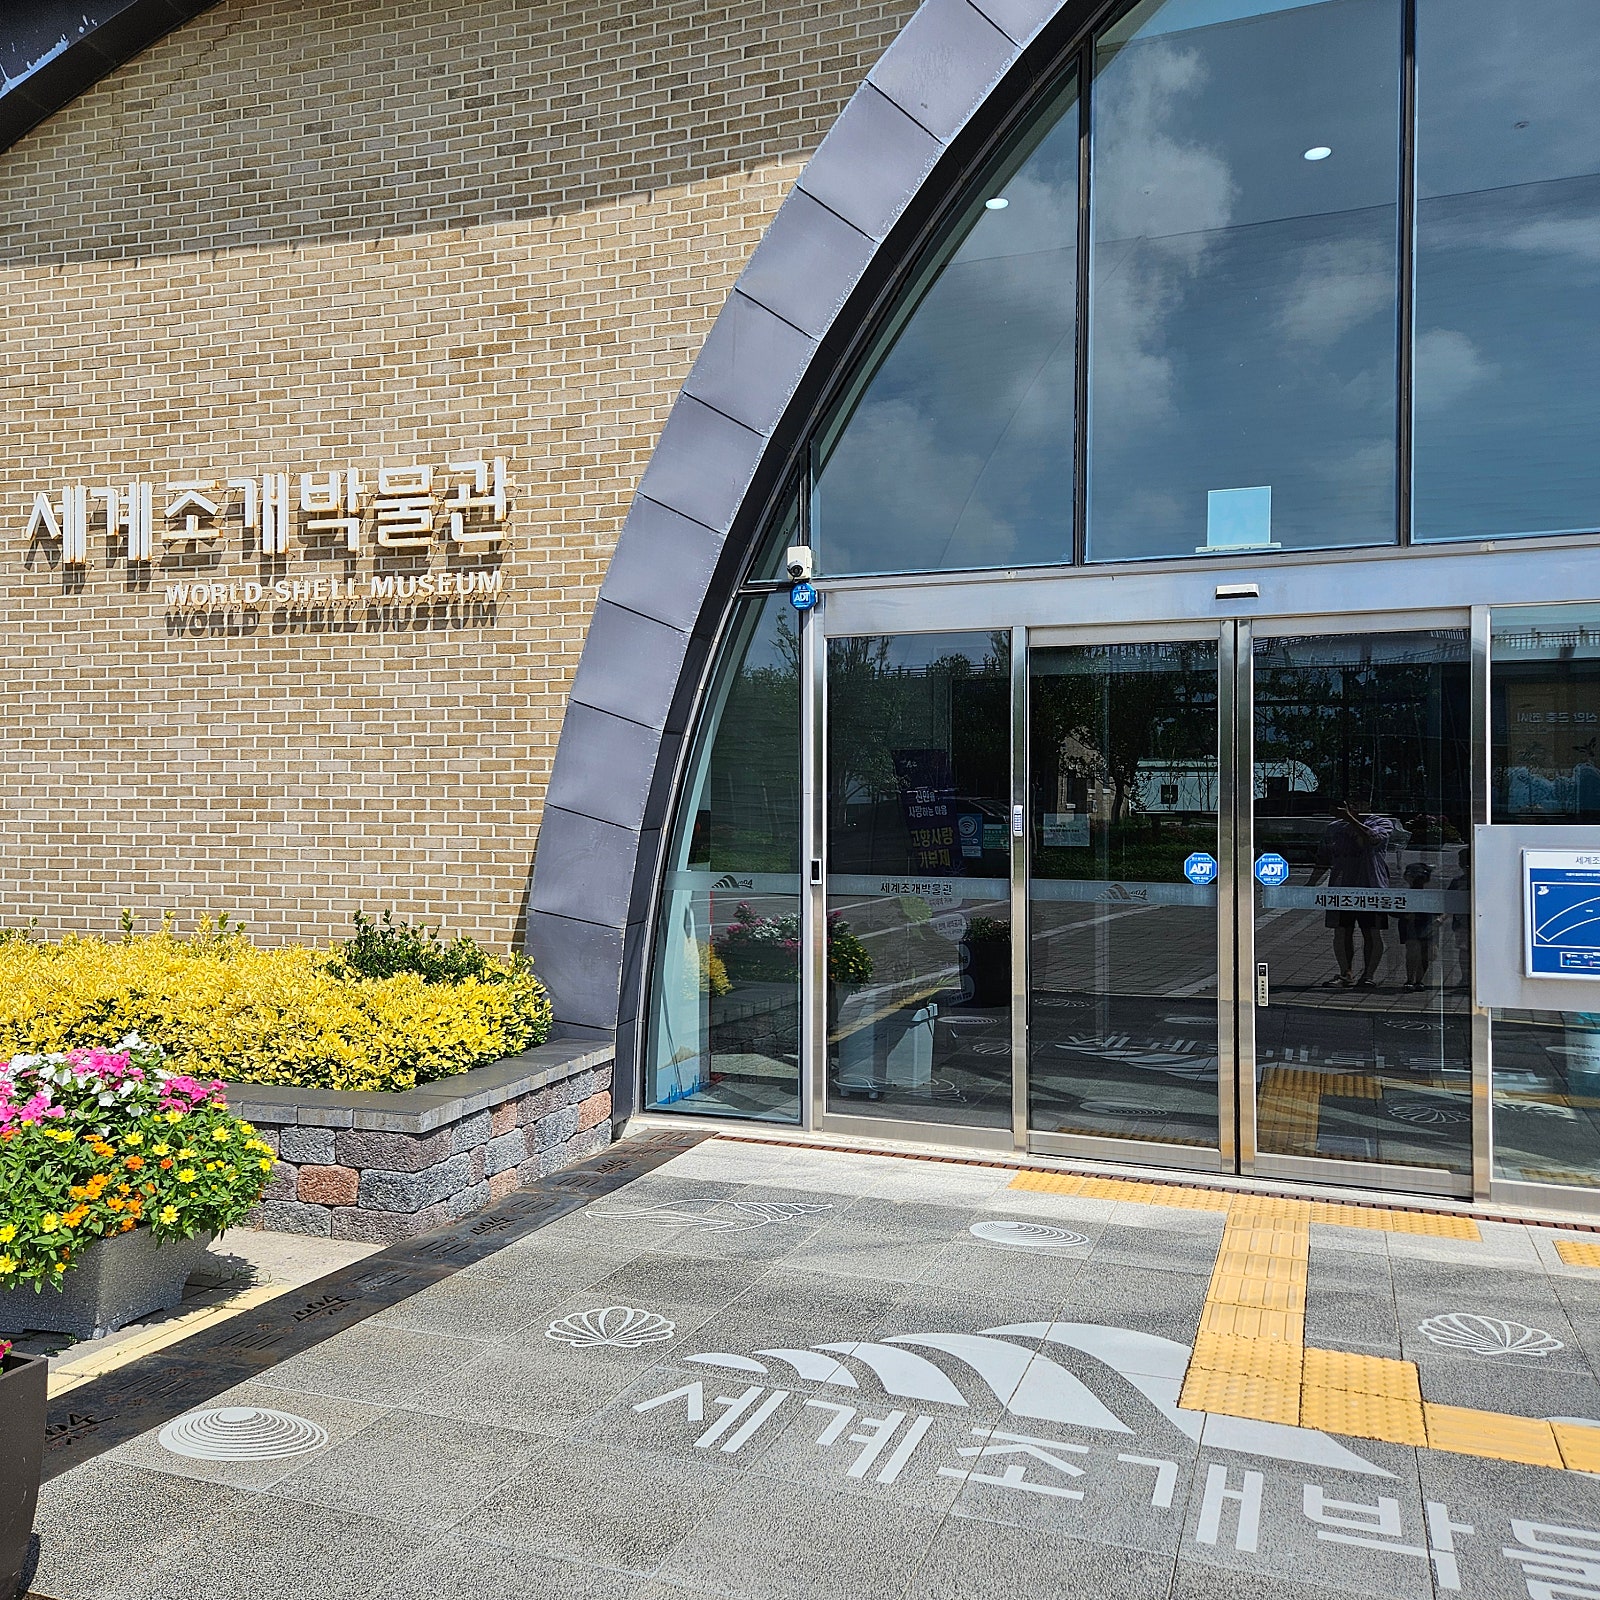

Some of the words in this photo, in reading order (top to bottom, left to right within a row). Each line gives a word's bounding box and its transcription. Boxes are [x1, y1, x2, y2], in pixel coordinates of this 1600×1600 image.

[25, 456, 513, 564] 세계조개박물관
[165, 581, 262, 607] WORLD
[275, 577, 360, 602] SHELL
[371, 570, 502, 599] MUSEUM
[793, 592, 810, 602] ADT
[911, 827, 954, 848] 고향사랑
[1189, 863, 1213, 875] ADT
[1260, 864, 1283, 876] ADT
[881, 882, 953, 896] 세계조개박물관
[1314, 894, 1407, 910] 세계조개박물관
